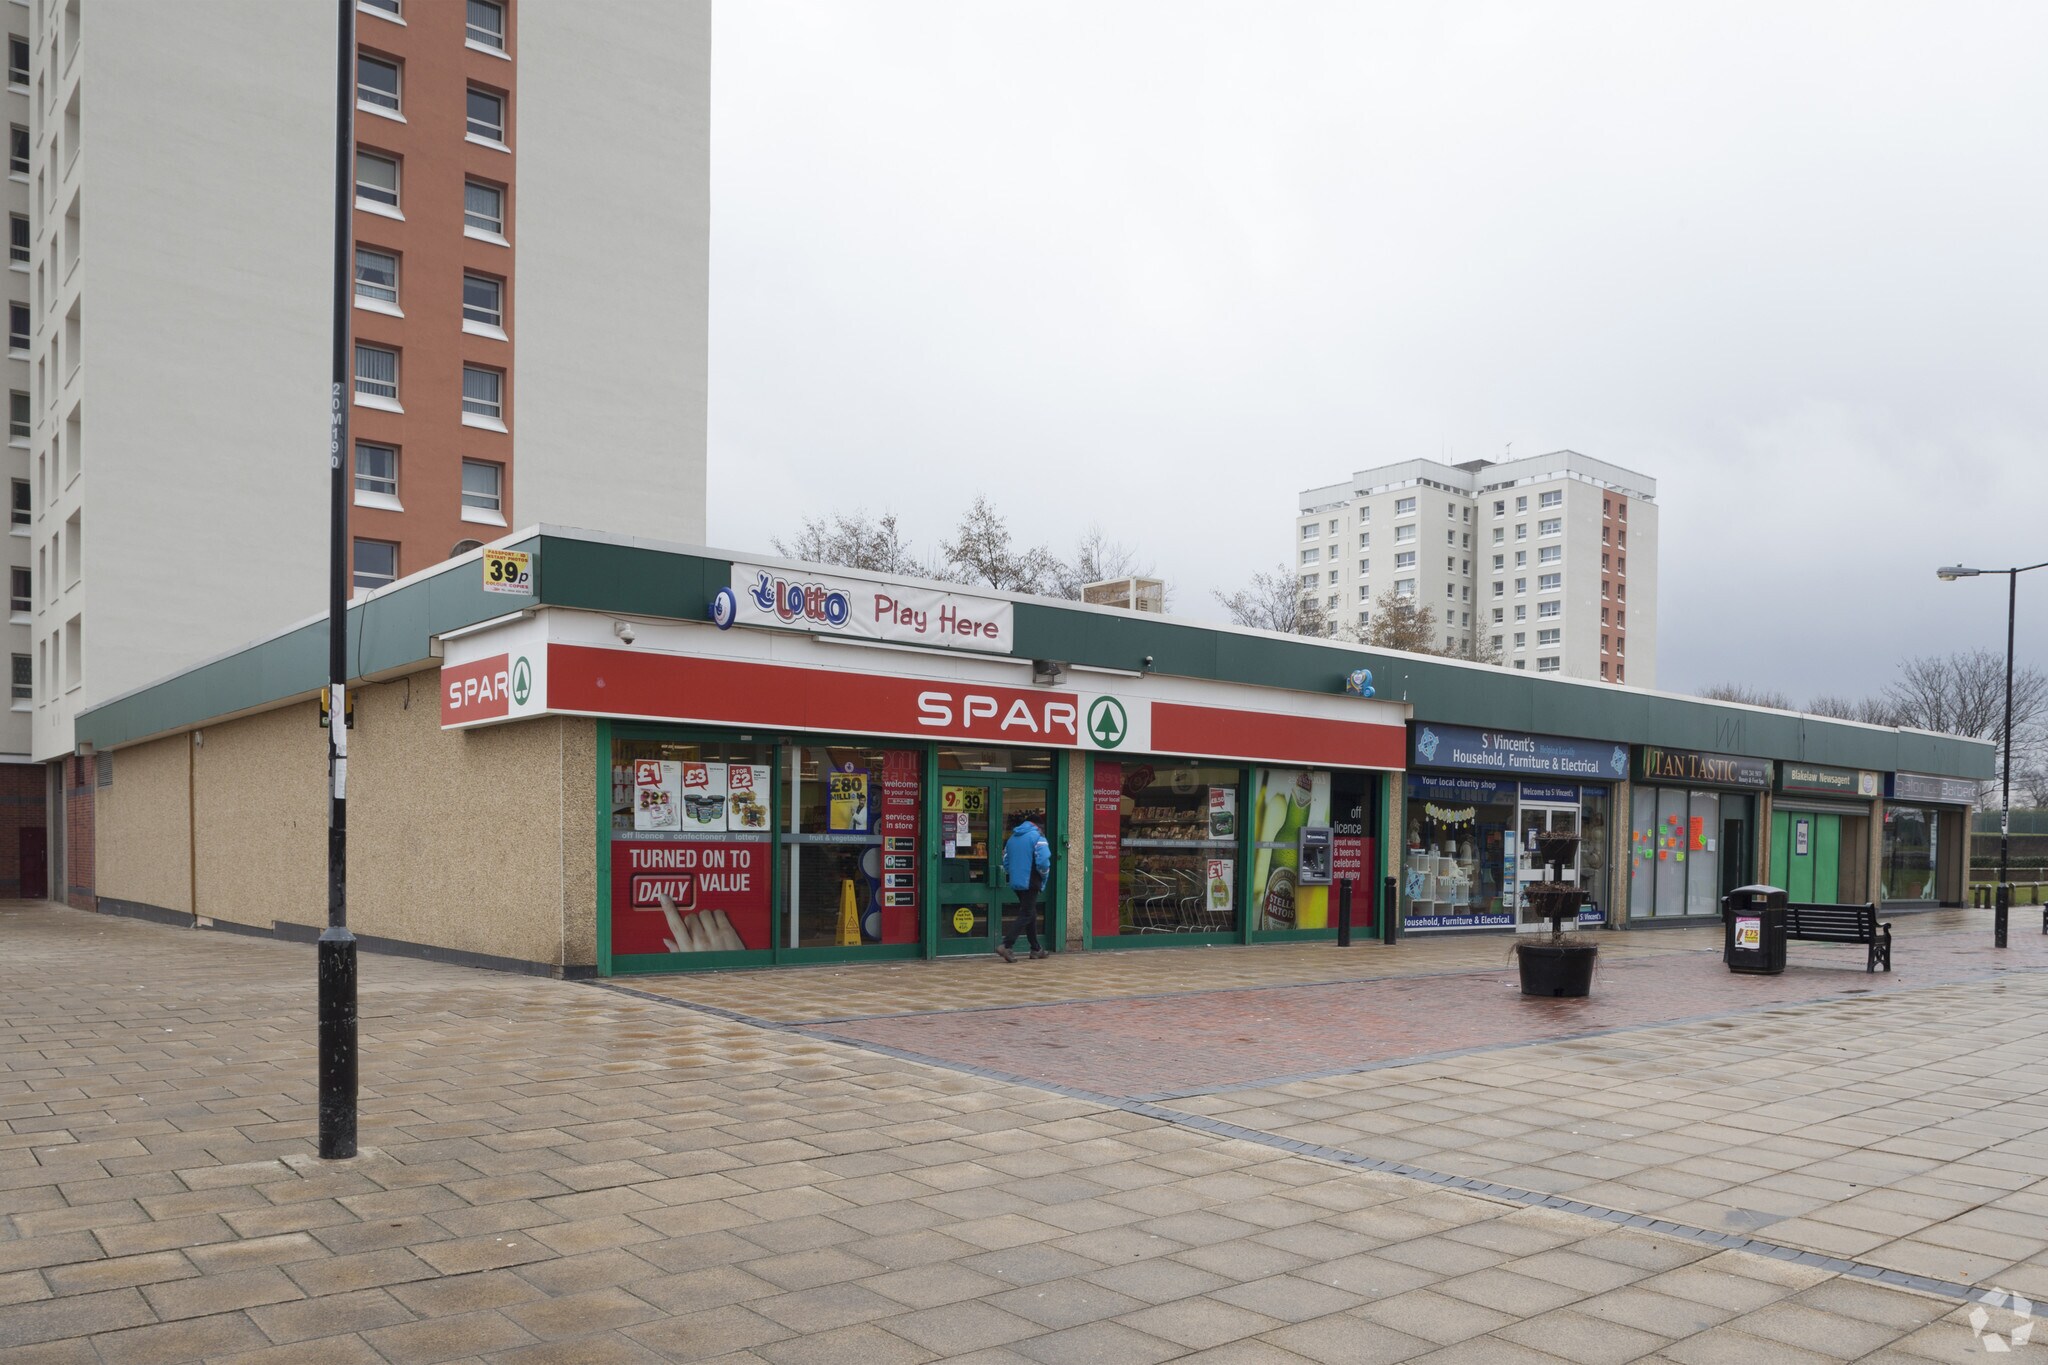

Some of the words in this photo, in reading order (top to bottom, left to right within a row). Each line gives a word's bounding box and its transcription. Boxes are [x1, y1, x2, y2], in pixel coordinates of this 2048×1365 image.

[490, 560, 529, 584] 39p
[874, 594, 927, 634] Play
[939, 604, 999, 639] Here
[449, 671, 508, 709] SPAR
[918, 691, 1076, 736] SPAR
[1494, 734, 1535, 753] Vincent's
[1453, 749, 1506, 768] Household,
[1509, 753, 1549, 770] Furniture
[1552, 757, 1559, 770] &
[1561, 758, 1599, 773] Electrical
[1654, 751, 1685, 777] TAN
[1688, 754, 1738, 782] TASTIC
[637, 763, 660, 783] £1
[685, 768, 706, 785] £3
[1791, 769, 1818, 782] Blakelaw
[1819, 772, 1850, 787] Newsagent
[731, 773, 751, 788] £2
[831, 777, 862, 793] £80
[884, 780, 918, 789] welcome
[1422, 776, 1437, 785] Your
[1439, 778, 1455, 786] local
[1456, 779, 1479, 789] charity
[1481, 780, 1496, 790] shop
[1522, 787, 1544, 796] Welcome
[885, 813, 915, 821] services
[1351, 806, 1362, 819] off
[886, 821, 894, 829] in
[894, 821, 913, 830] store
[1334, 821, 1361, 834] licence
[635, 832, 664, 840] licence
[673, 833, 727, 842] confectionery
[735, 833, 760, 842] lottery
[1334, 839, 1346, 847] great
[629, 849, 697, 868] TURNED
[702, 849, 724, 868] ON
[730, 850, 750, 868] TO
[1334, 848, 1338, 856] &
[1340, 848, 1354, 856] beers
[1209, 864, 1222, 877] £1
[1334, 859, 1360, 868] celebrate
[1345, 871, 1361, 880] enjoy
[638, 881, 690, 902] DAILY
[699, 873, 750, 892] VALUE
[1269, 893, 1295, 908] STELLA
[1267, 904, 1294, 918] ARTOIS
[1442, 916, 1472, 926] Furniture
[1474, 916, 1479, 924] &
[1481, 915, 1510, 924] Electrical
